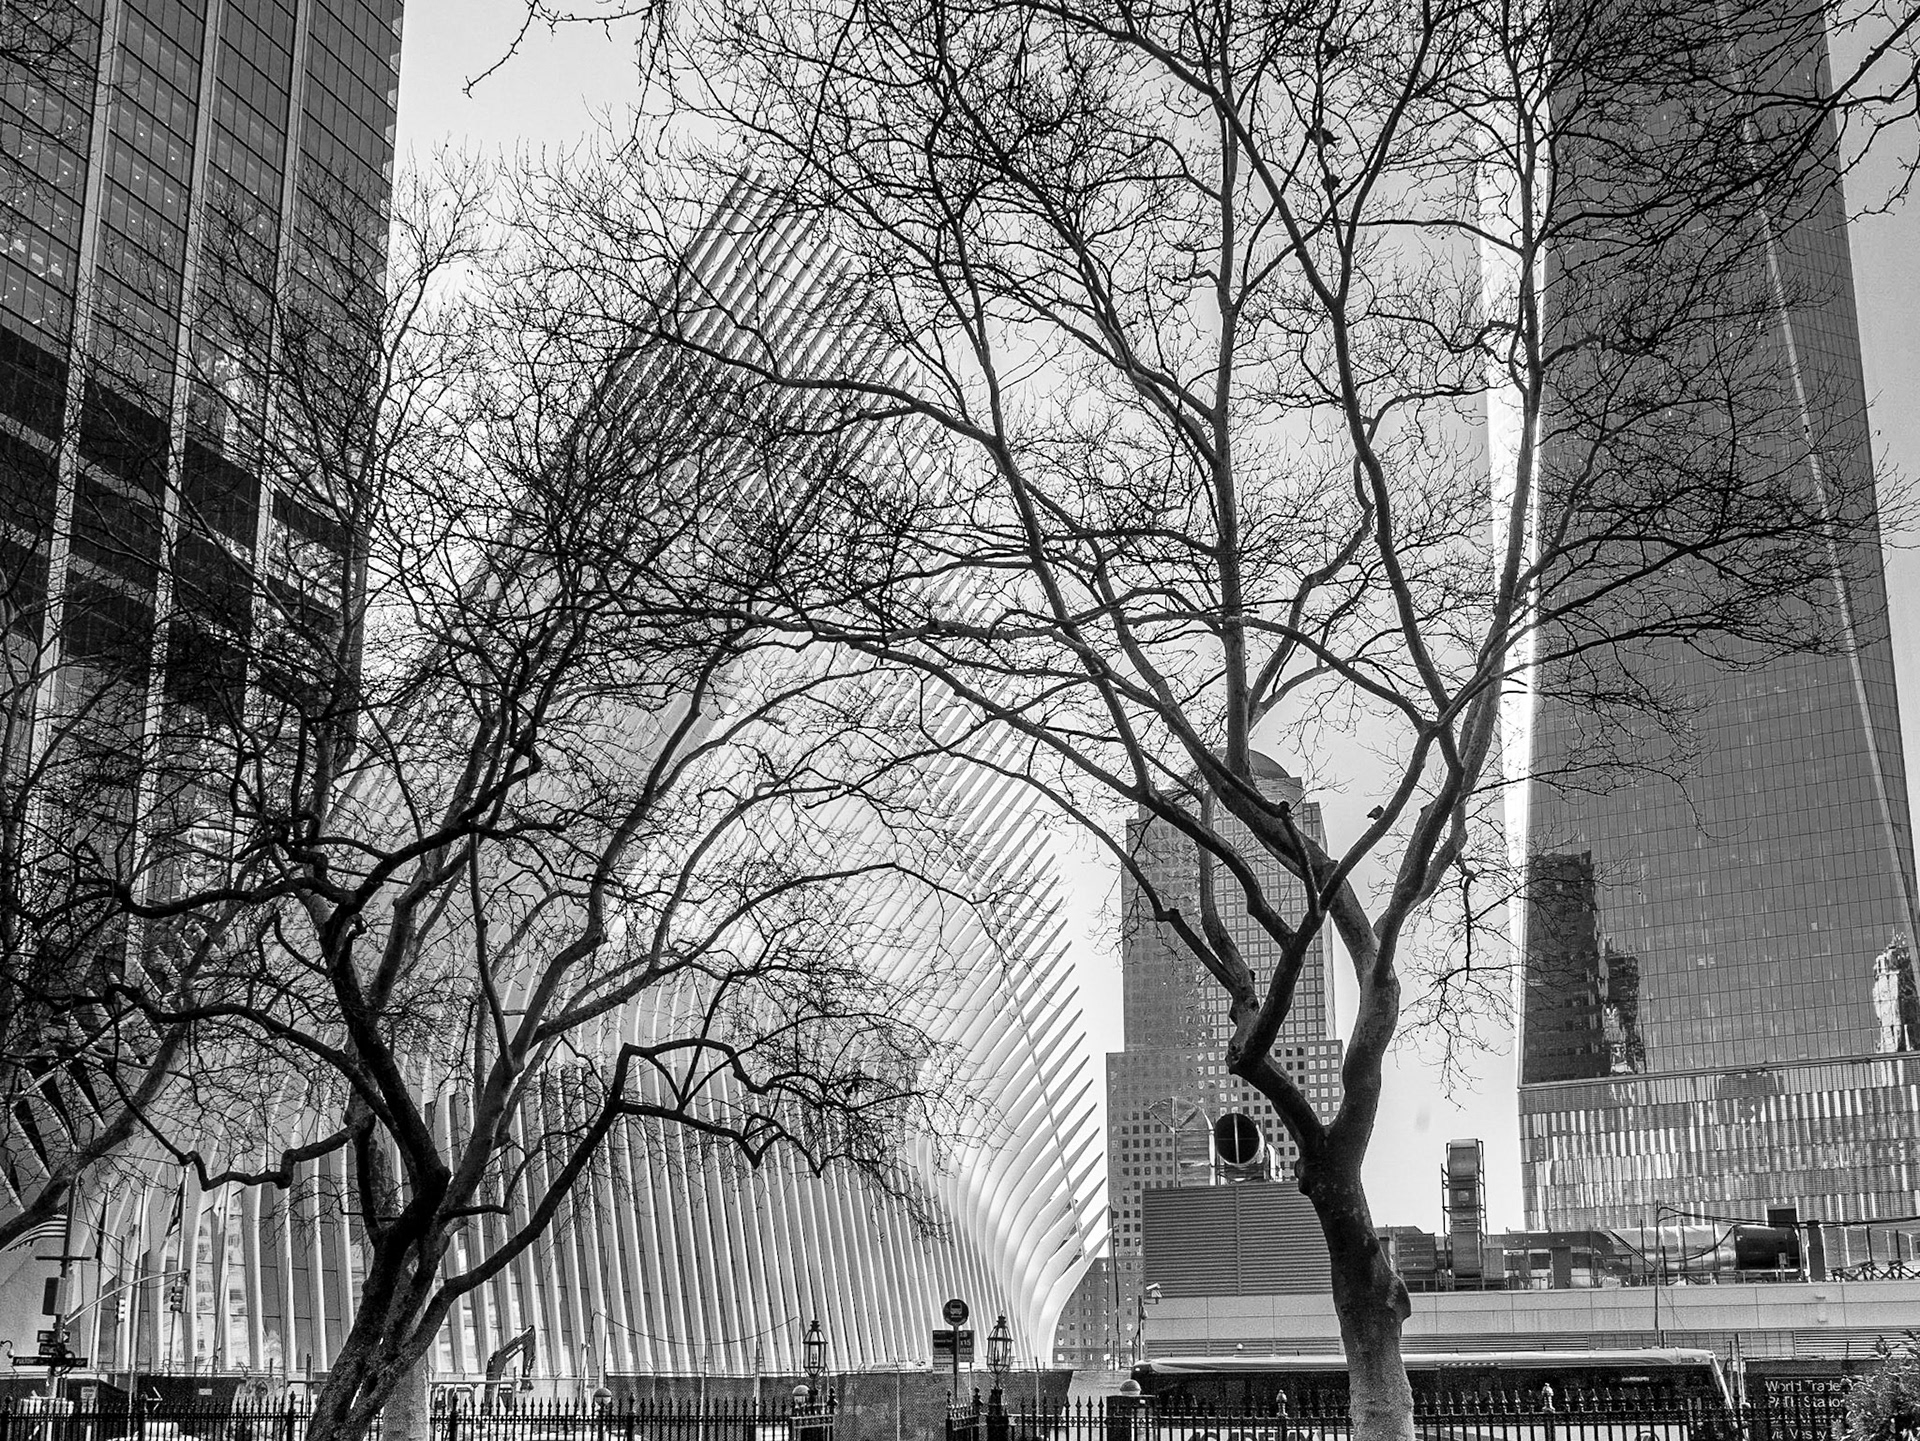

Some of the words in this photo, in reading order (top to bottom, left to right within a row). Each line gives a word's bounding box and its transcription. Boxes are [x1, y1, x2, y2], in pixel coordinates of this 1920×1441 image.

[1765, 1380, 1802, 1391] World
[1804, 1380, 1840, 1391] Trade
[1804, 1395, 1845, 1408] Staio
